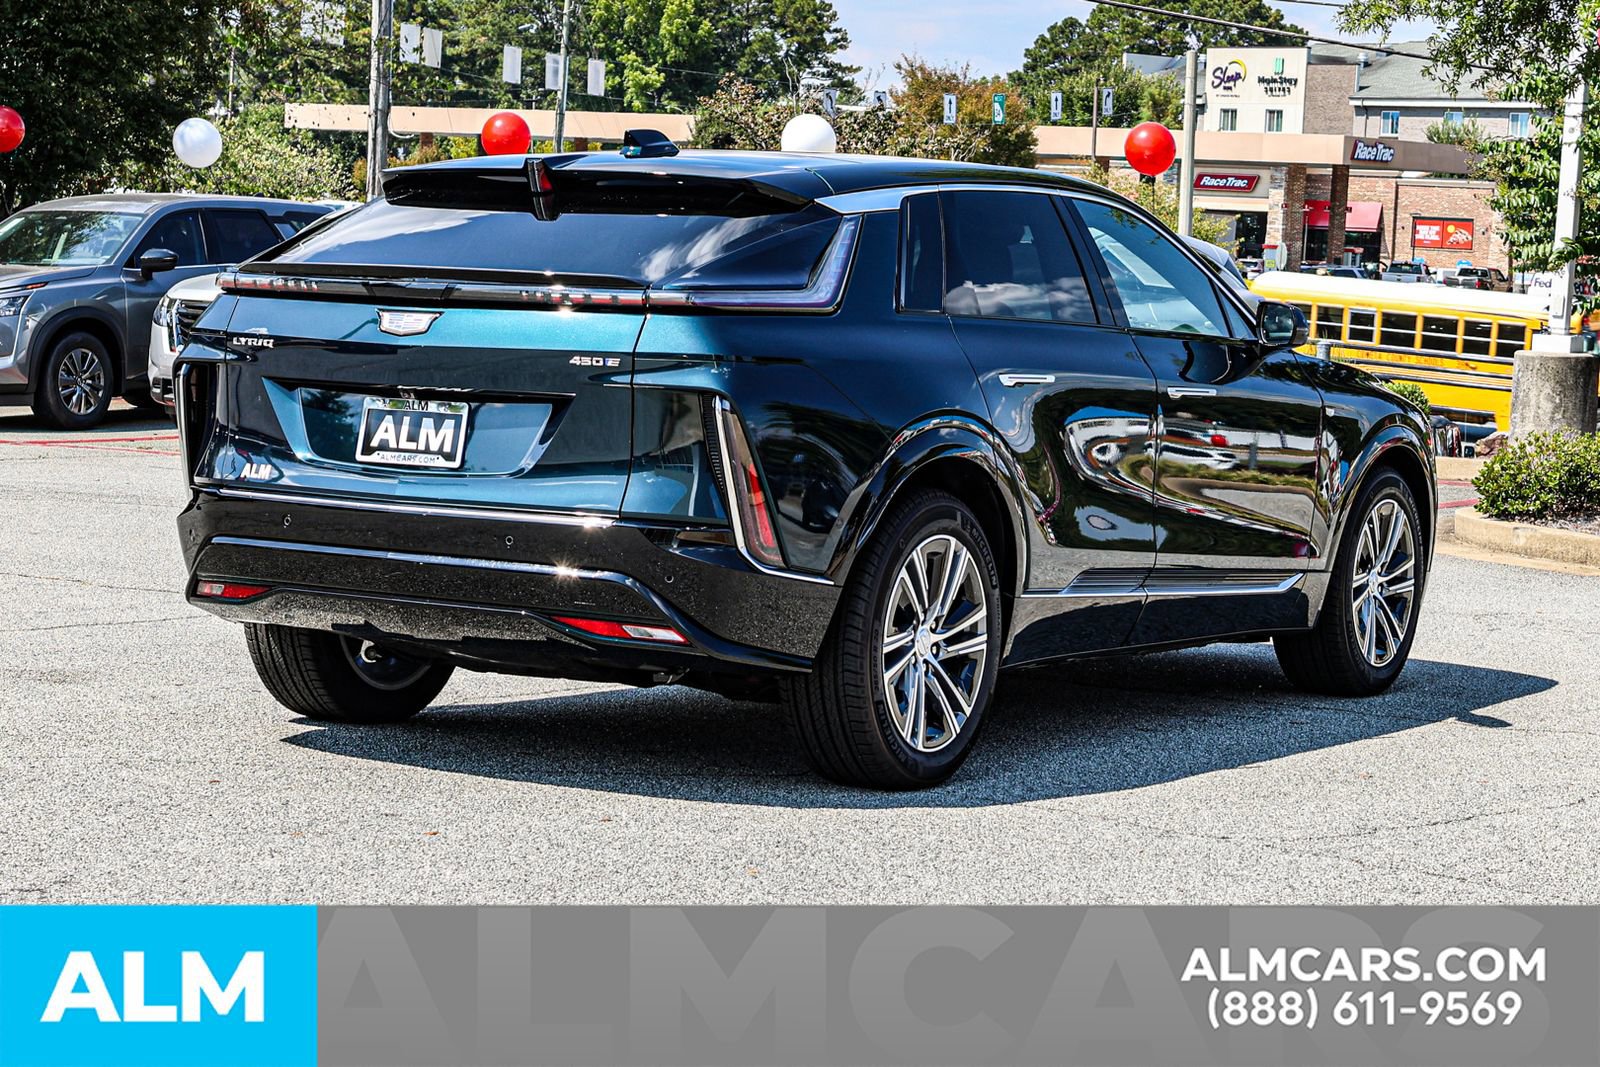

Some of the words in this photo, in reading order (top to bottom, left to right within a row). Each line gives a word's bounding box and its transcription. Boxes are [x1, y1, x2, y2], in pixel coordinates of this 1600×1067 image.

[1211, 66, 1242, 89] Sleep
[1354, 140, 1395, 161] RaceTrac
[1200, 176, 1248, 187] RaceTrac
[232, 336, 275, 348] LYRIQ
[569, 355, 604, 366] 450
[403, 401, 430, 411] ALM
[369, 414, 456, 453] ALM
[240, 462, 272, 480] ALM
[971, 527, 998, 586] MICHELIN
